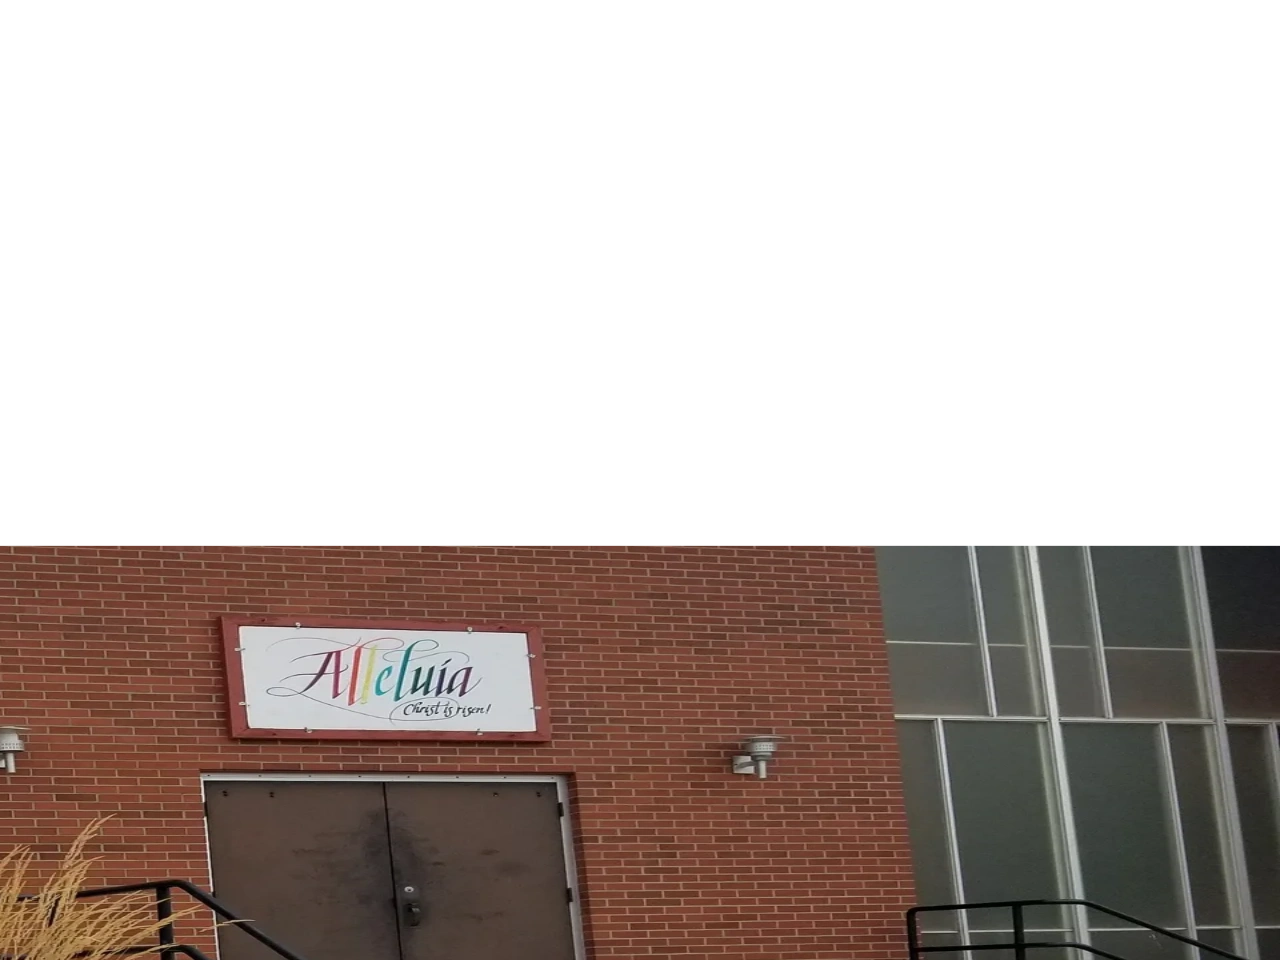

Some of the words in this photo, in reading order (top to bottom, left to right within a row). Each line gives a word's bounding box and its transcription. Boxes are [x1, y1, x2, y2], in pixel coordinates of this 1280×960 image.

[266, 637, 483, 706] Alleluia
[403, 701, 441, 716] Christ
[443, 702, 454, 717] is
[456, 704, 491, 717] risen!
